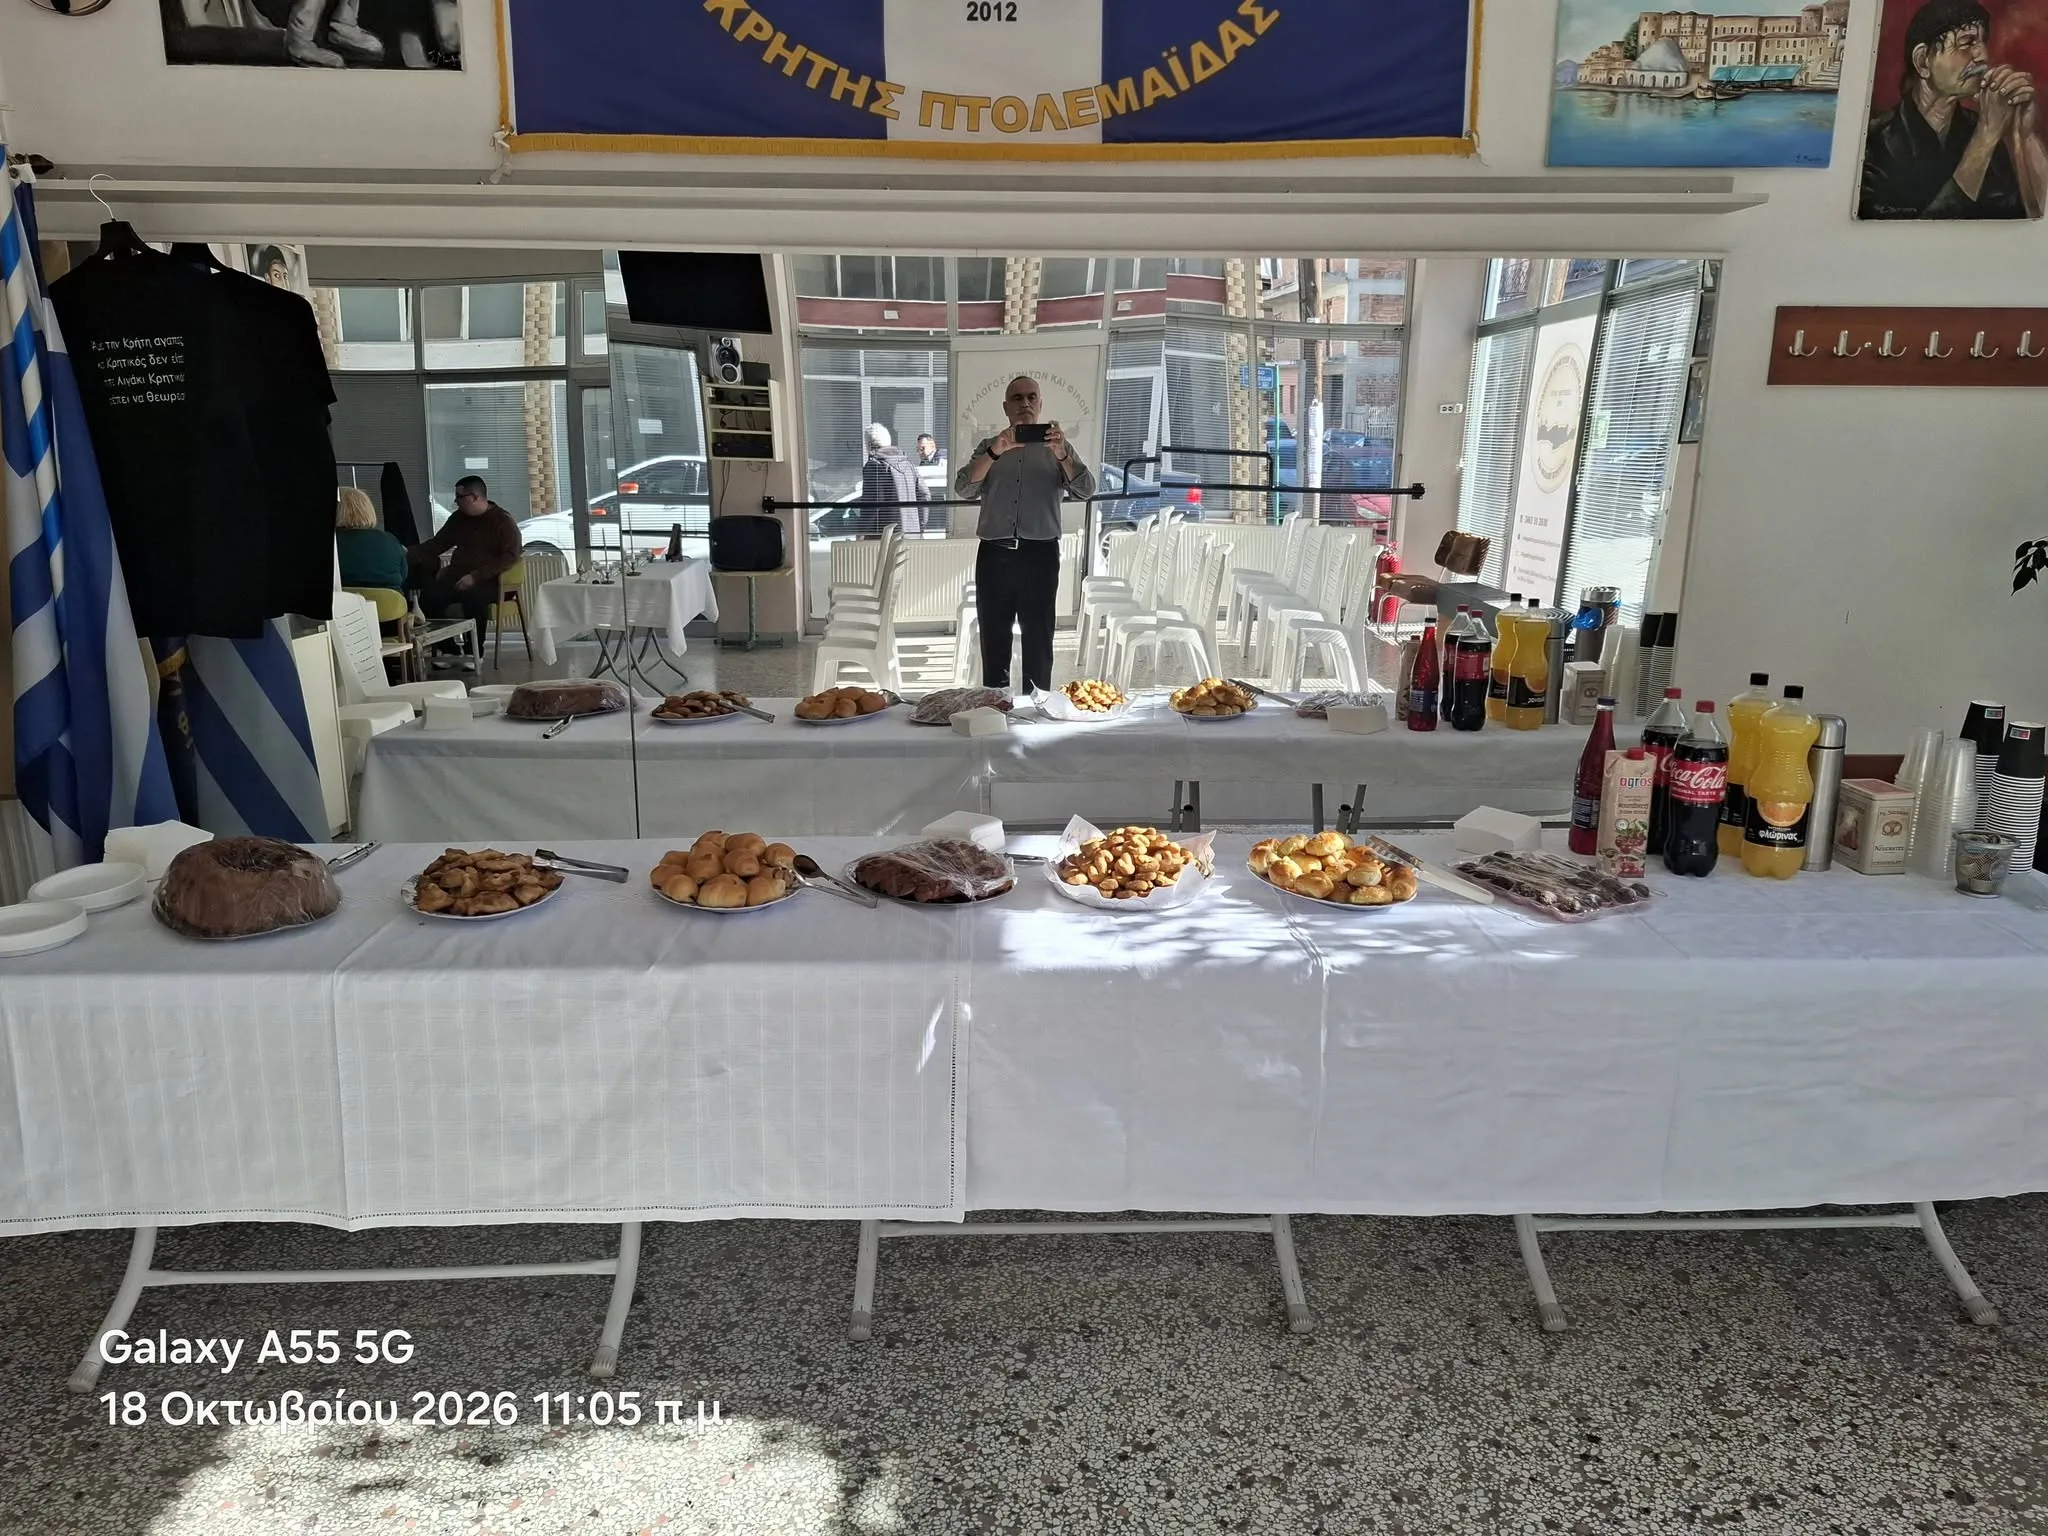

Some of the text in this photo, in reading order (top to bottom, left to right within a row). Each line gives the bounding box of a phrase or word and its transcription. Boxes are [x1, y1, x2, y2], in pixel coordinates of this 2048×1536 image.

[966, 0, 1017, 22] 2012
[703, 0, 1280, 134] ΚΡΗΤΗΣ ΠΤΟΛΕΜΑΪΔΑΣ
[122, 337, 153, 351] Κρήτη
[106, 354, 147, 371] Κρητικός
[149, 354, 168, 366] δεν
[132, 394, 146, 404] να
[1619, 776, 1653, 789] agros
[1758, 829, 1798, 841] φλώρινας
